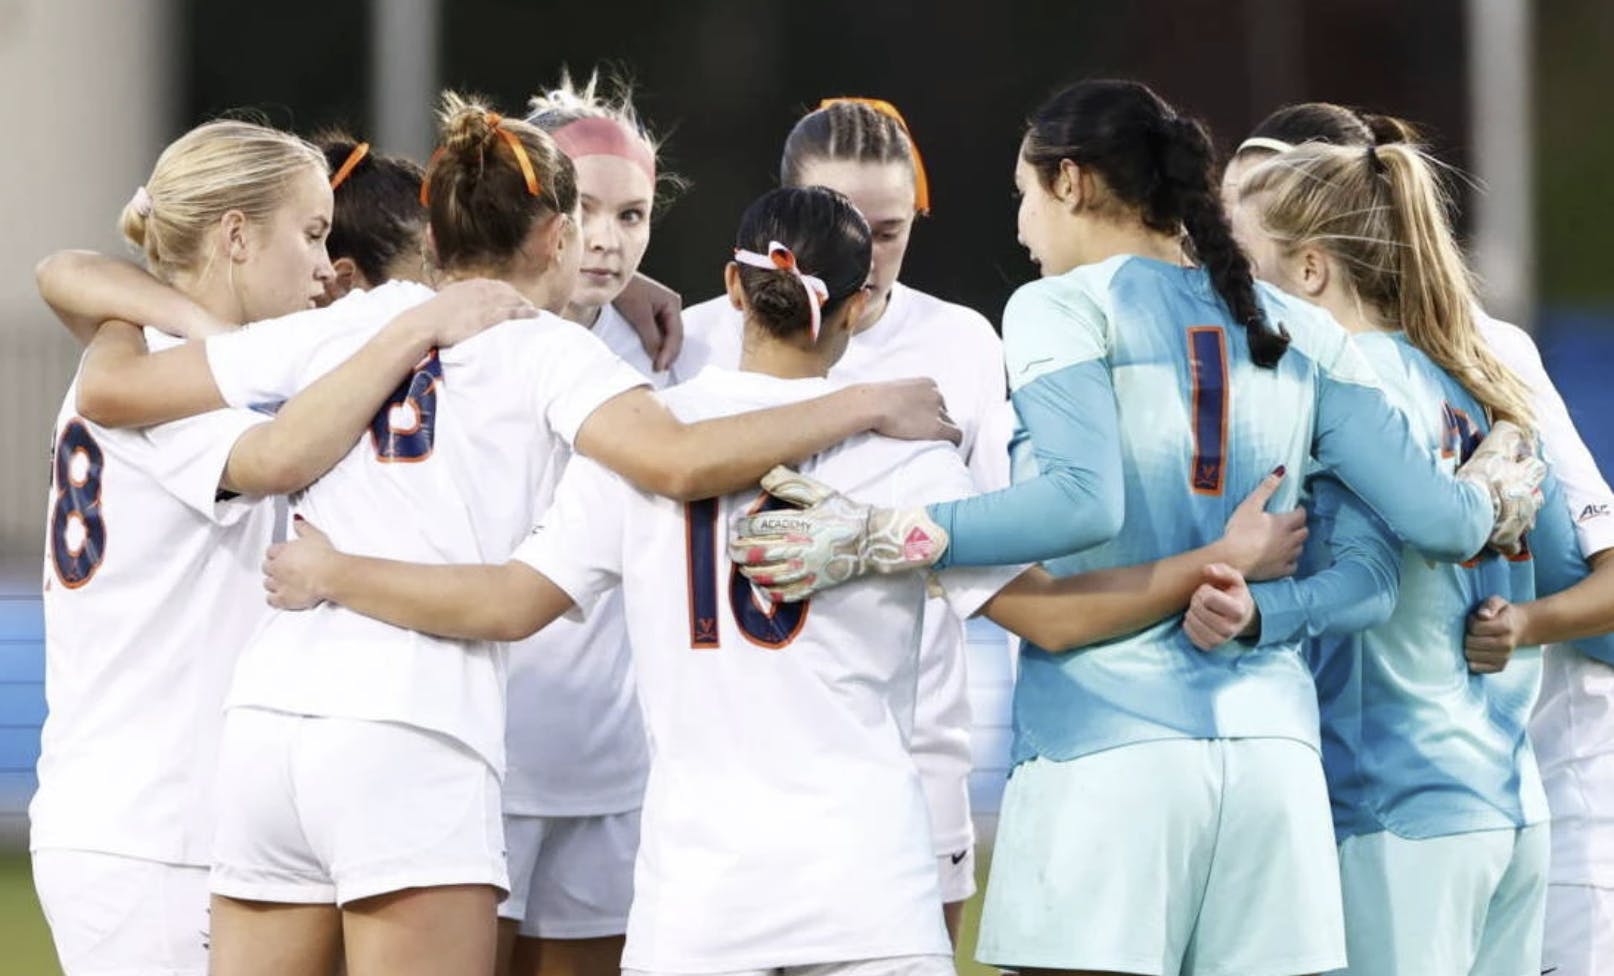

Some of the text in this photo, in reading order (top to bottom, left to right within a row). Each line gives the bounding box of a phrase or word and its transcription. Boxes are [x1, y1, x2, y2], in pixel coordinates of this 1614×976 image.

[1187, 326, 1230, 496] 1
[45, 416, 107, 590] 8
[760, 518, 812, 532] ACADEMY
